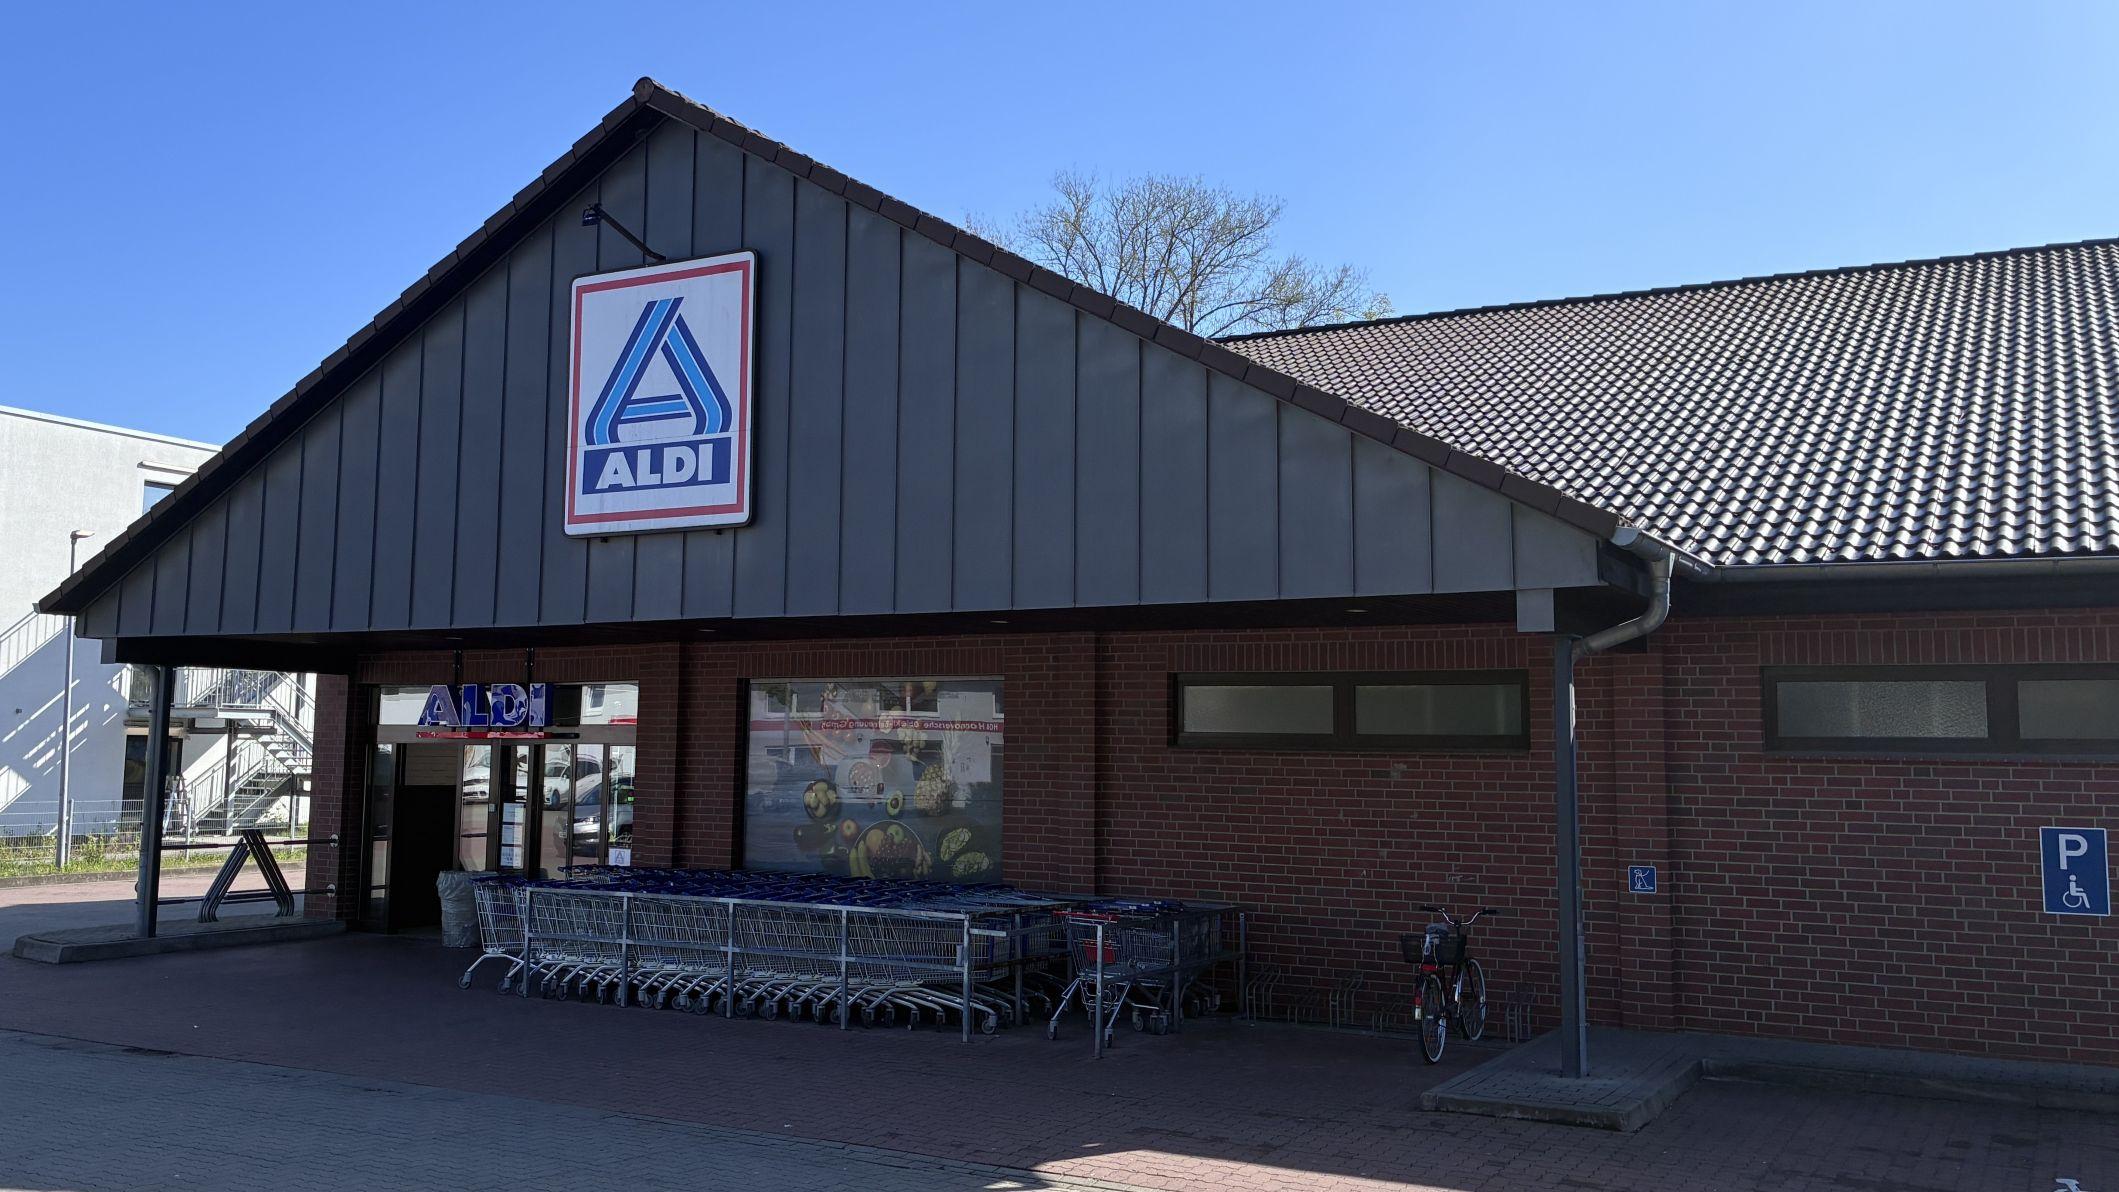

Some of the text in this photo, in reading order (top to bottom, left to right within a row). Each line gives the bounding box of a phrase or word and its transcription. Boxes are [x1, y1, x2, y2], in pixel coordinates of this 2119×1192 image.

[595, 443, 713, 490] ALDI
[417, 683, 546, 727] ALDI
[2058, 834, 2088, 870] P
